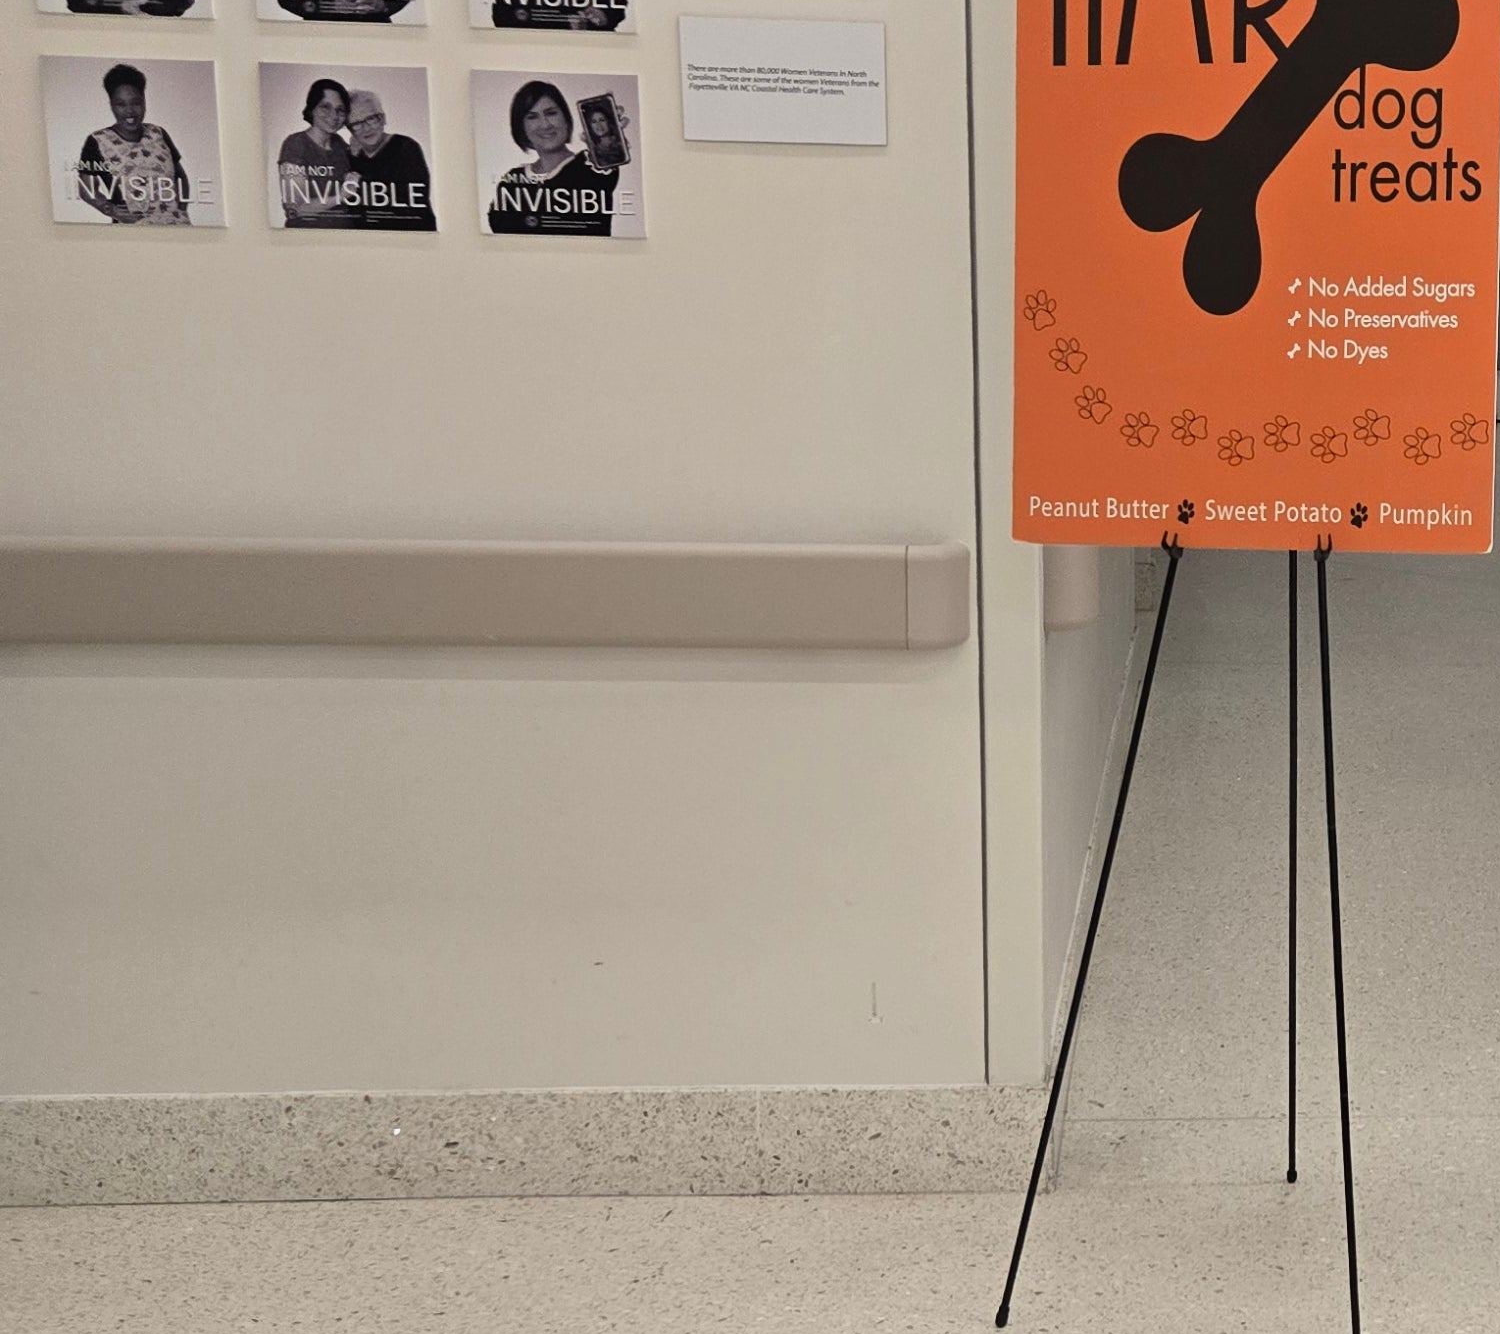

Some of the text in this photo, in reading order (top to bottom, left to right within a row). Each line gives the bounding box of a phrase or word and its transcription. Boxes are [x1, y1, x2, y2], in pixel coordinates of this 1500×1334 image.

[781, 67, 807, 76] Women
[808, 68, 838, 77] Veterans
[847, 70, 867, 78] North
[820, 78, 850, 87] Veterans
[850, 79, 867, 87] from
[1333, 65, 1443, 150] dog
[287, 164, 306, 176] AM
[308, 165, 335, 177] NOT
[1332, 148, 1482, 203] treats
[281, 178, 427, 208] INVISIBLE
[1309, 275, 1476, 303] No Added Sugars
[1308, 308, 1459, 329] No Preservatives
[1307, 339, 1389, 365] No Dyes
[1029, 495, 1473, 530] Peanut Butter Sweet Potato Pumpkin
